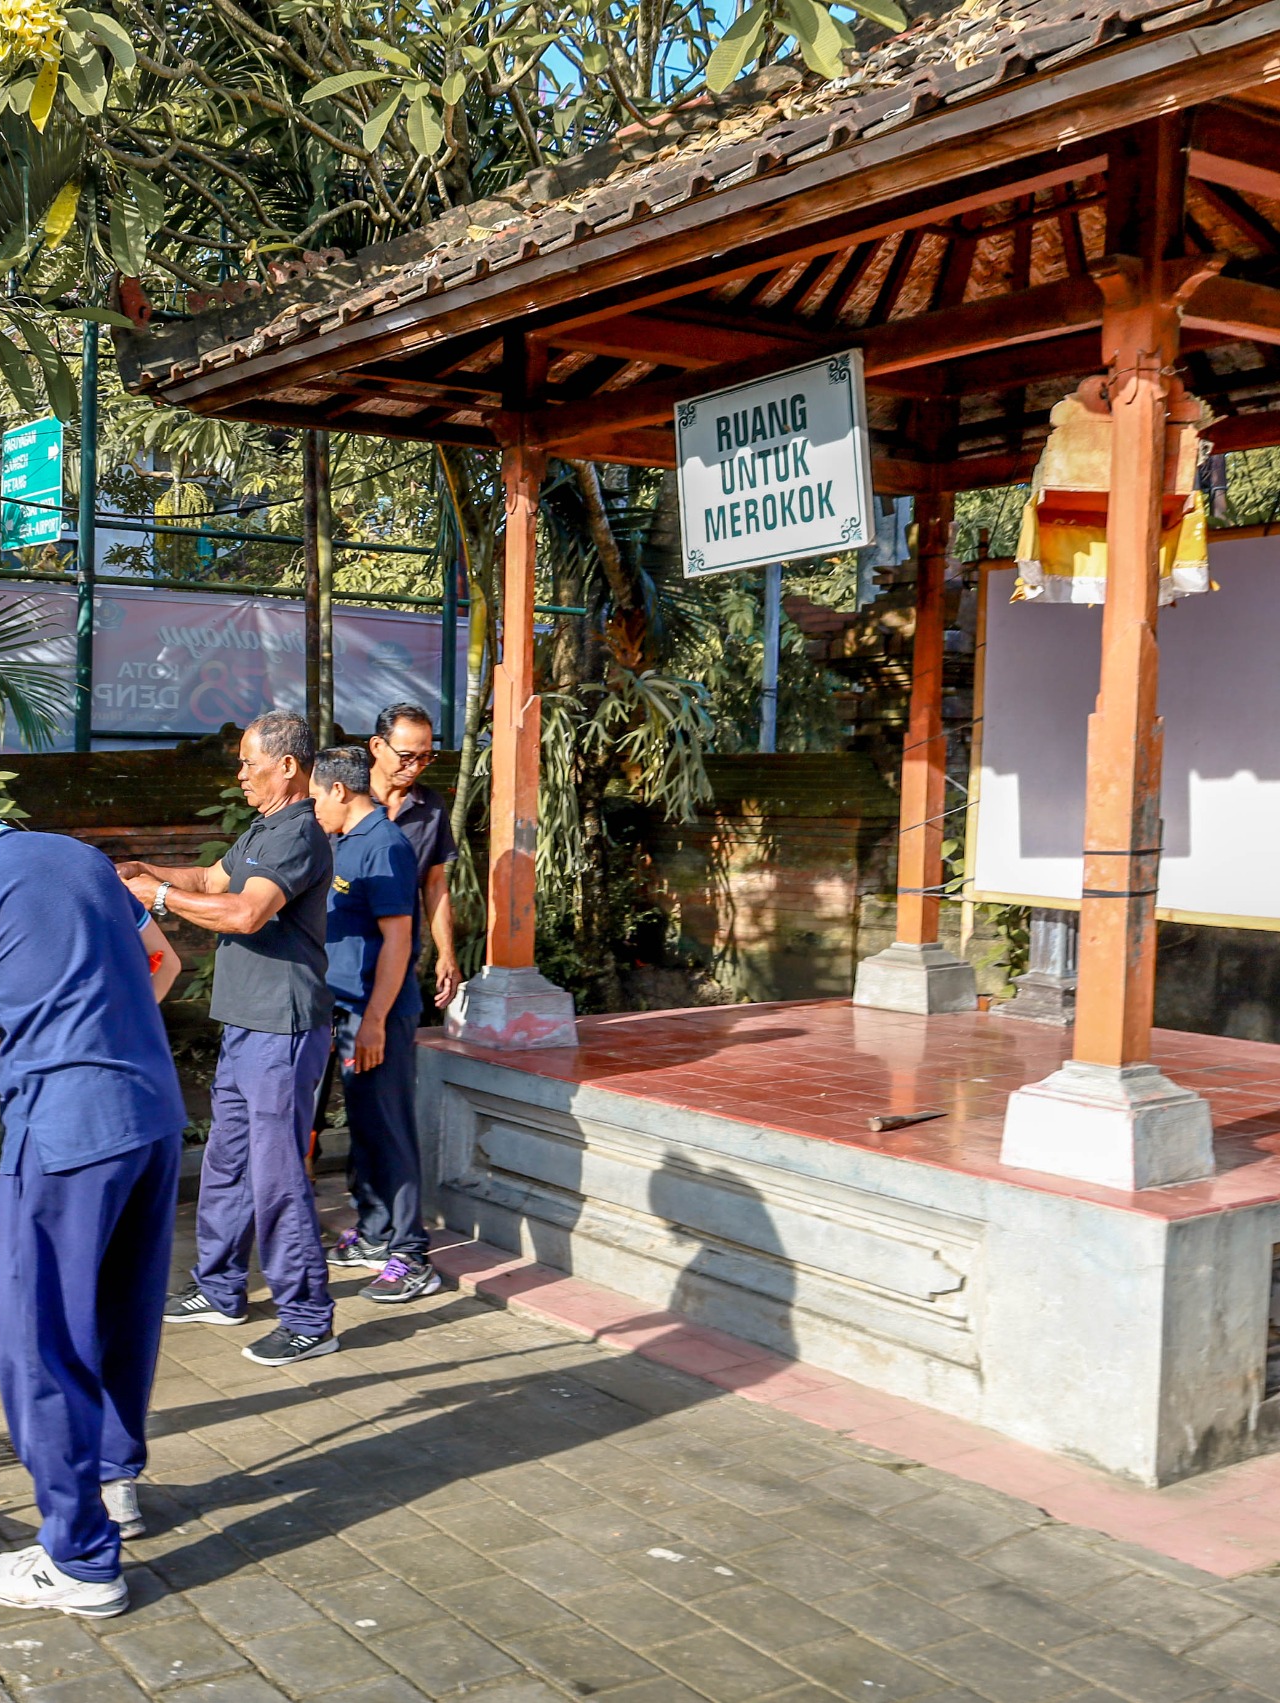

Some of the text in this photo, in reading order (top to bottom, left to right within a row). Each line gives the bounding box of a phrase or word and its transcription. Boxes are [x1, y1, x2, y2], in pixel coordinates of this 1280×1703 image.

[716, 393, 808, 453] RUANG
[720, 438, 811, 495] UNTUK
[704, 480, 836, 543] MEROKOK
